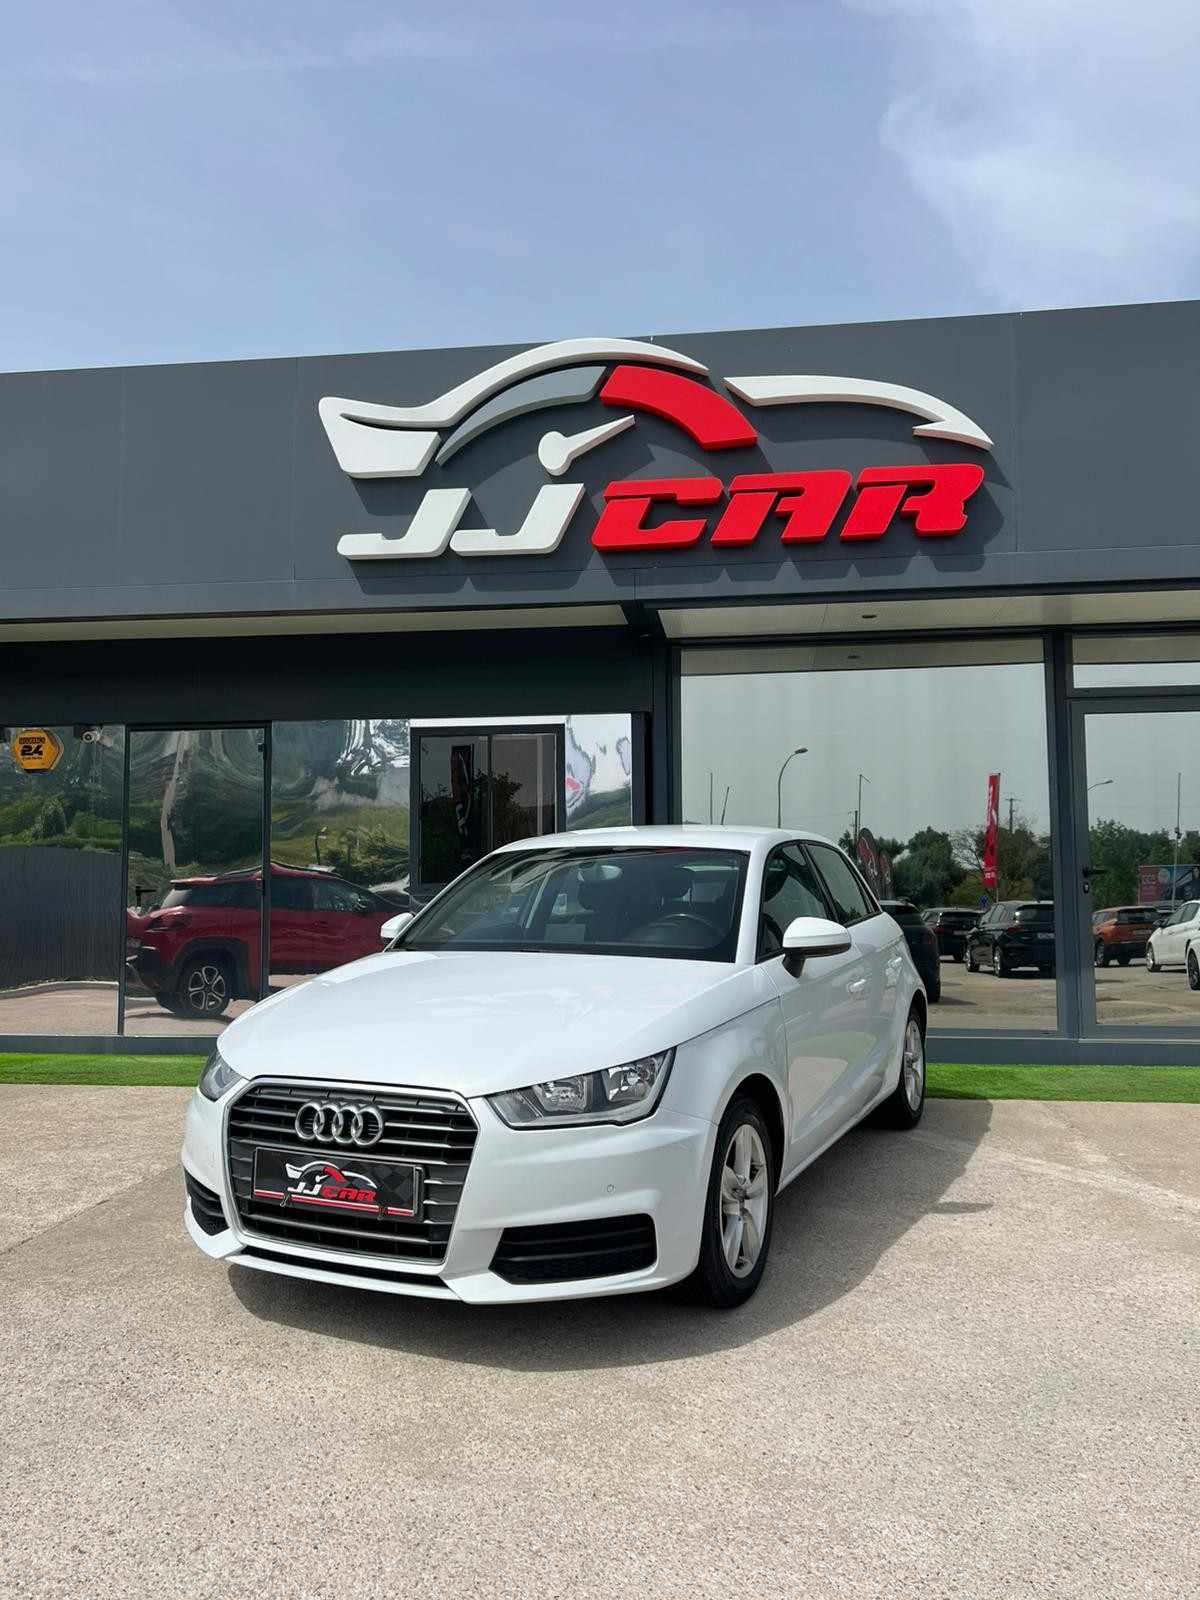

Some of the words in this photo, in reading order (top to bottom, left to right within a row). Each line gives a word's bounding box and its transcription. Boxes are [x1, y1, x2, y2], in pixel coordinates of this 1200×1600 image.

[337, 485, 584, 559] JJ
[591, 464, 985, 550] CAR
[21, 745, 43, 756] 24
[287, 1182, 321, 1195] JJ
[321, 1185, 377, 1202] CAR
